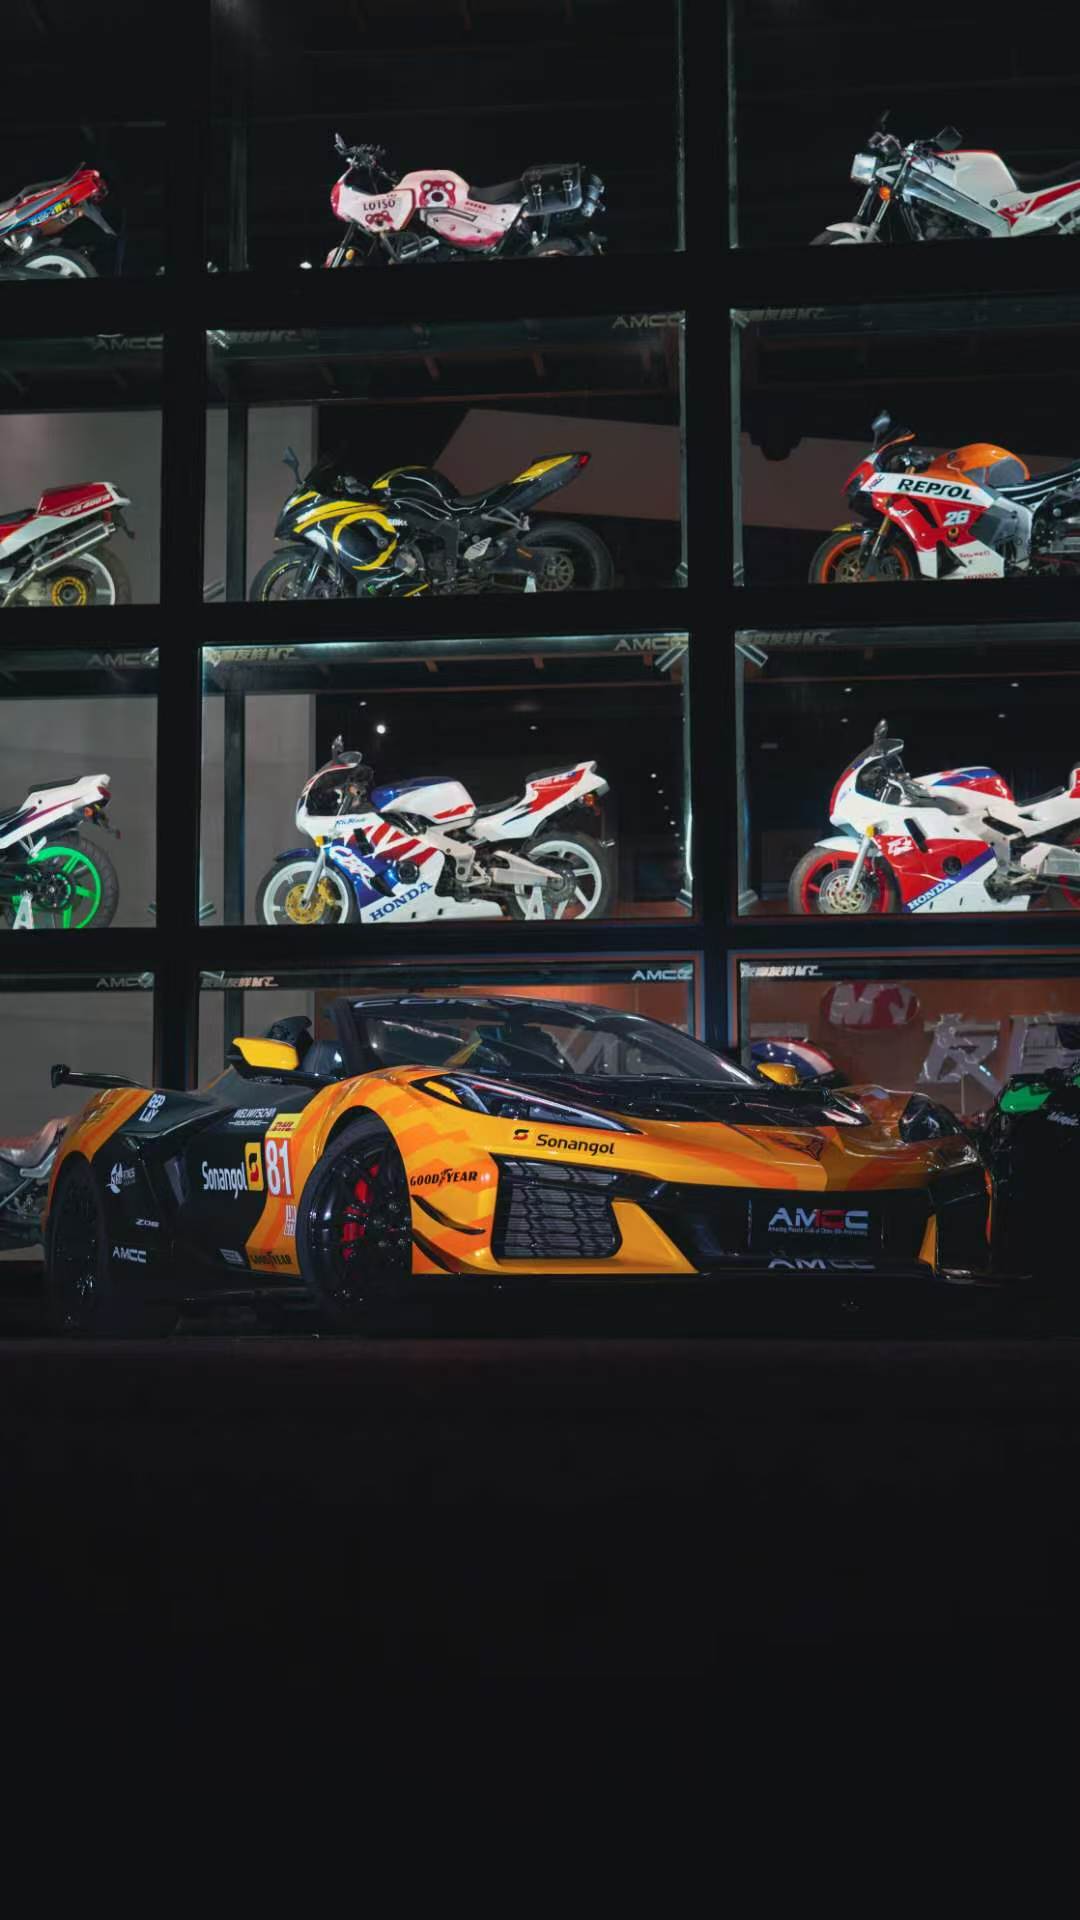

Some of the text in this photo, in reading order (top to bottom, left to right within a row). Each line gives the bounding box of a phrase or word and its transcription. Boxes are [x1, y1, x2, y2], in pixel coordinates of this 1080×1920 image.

[897, 478, 973, 501] REPSOL
[943, 510, 970, 526] 26
[369, 882, 433, 921] HONDA
[907, 878, 957, 910] HONDA
[96, 974, 154, 989] AMC
[536, 1133, 615, 1156] Sonangol
[265, 1139, 292, 1196] 81
[410, 1168, 478, 1187] GOODYEAR
[201, 1160, 247, 1199] Sonangol
[768, 1207, 869, 1230] AMCC
[112, 1245, 147, 1264] AMCC
